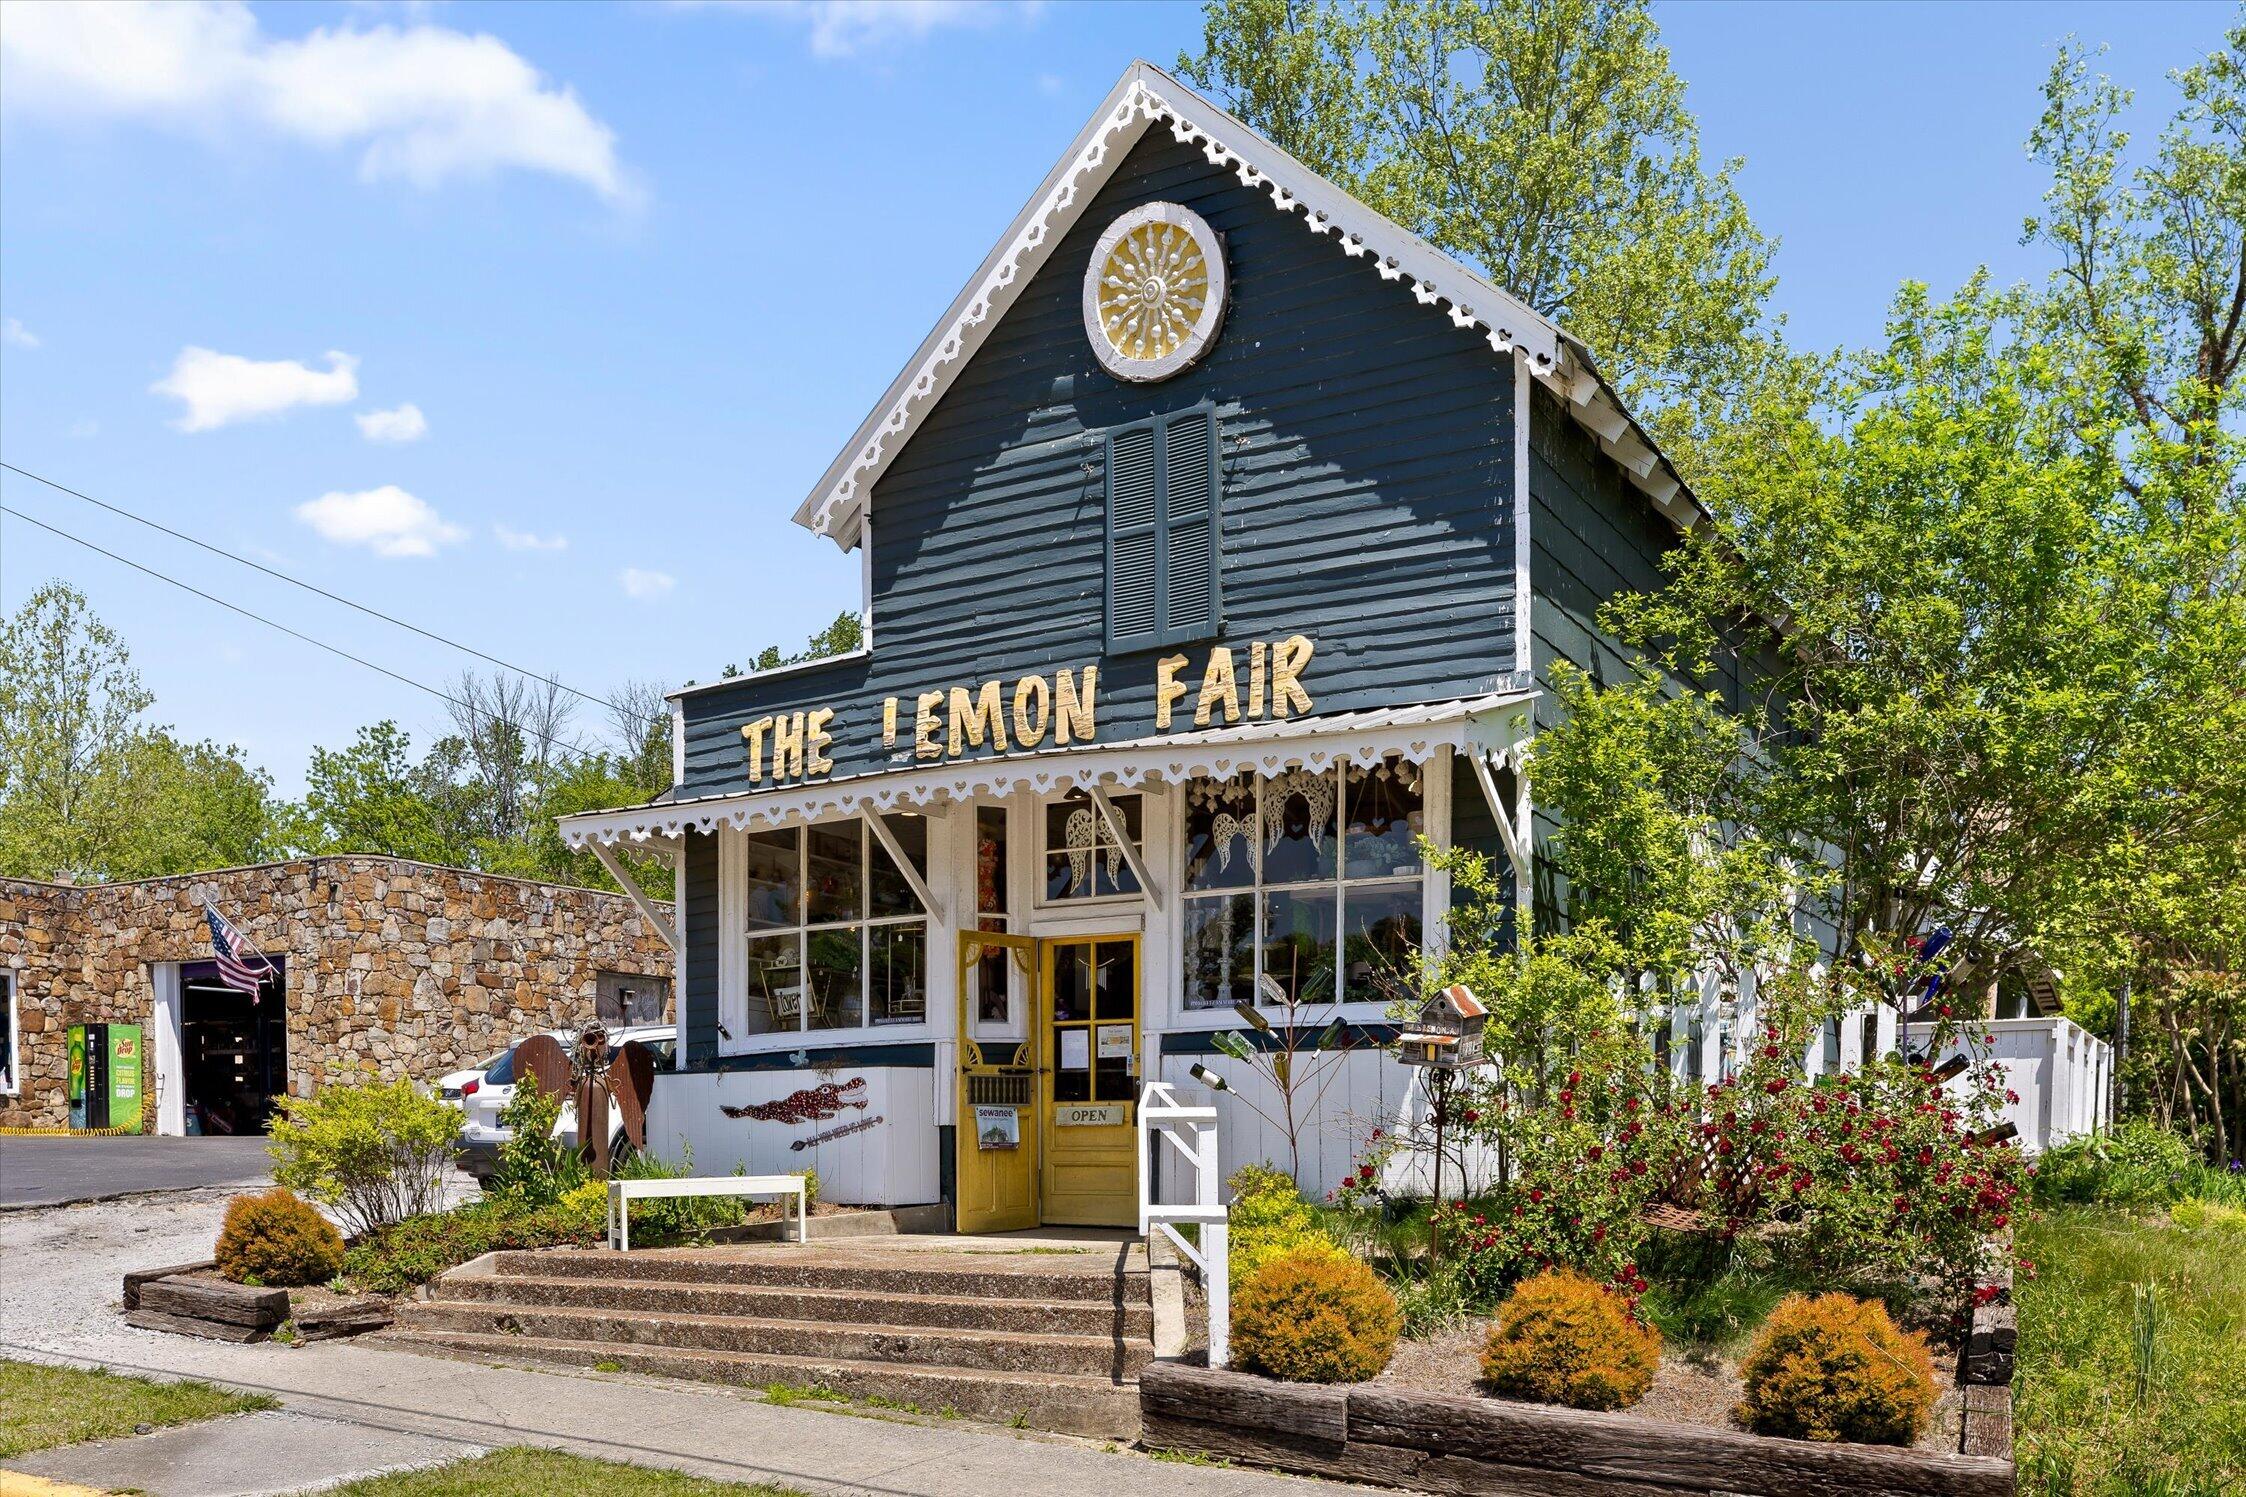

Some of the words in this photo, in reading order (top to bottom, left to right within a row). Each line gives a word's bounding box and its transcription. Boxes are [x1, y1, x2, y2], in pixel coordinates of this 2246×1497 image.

[741, 707, 834, 782] THE
[1156, 635, 1314, 729] FAIR
[116, 1089, 135, 1098] DROP
[979, 1109, 1013, 1118] sewanee
[1071, 1110, 1107, 1121] OPEN
